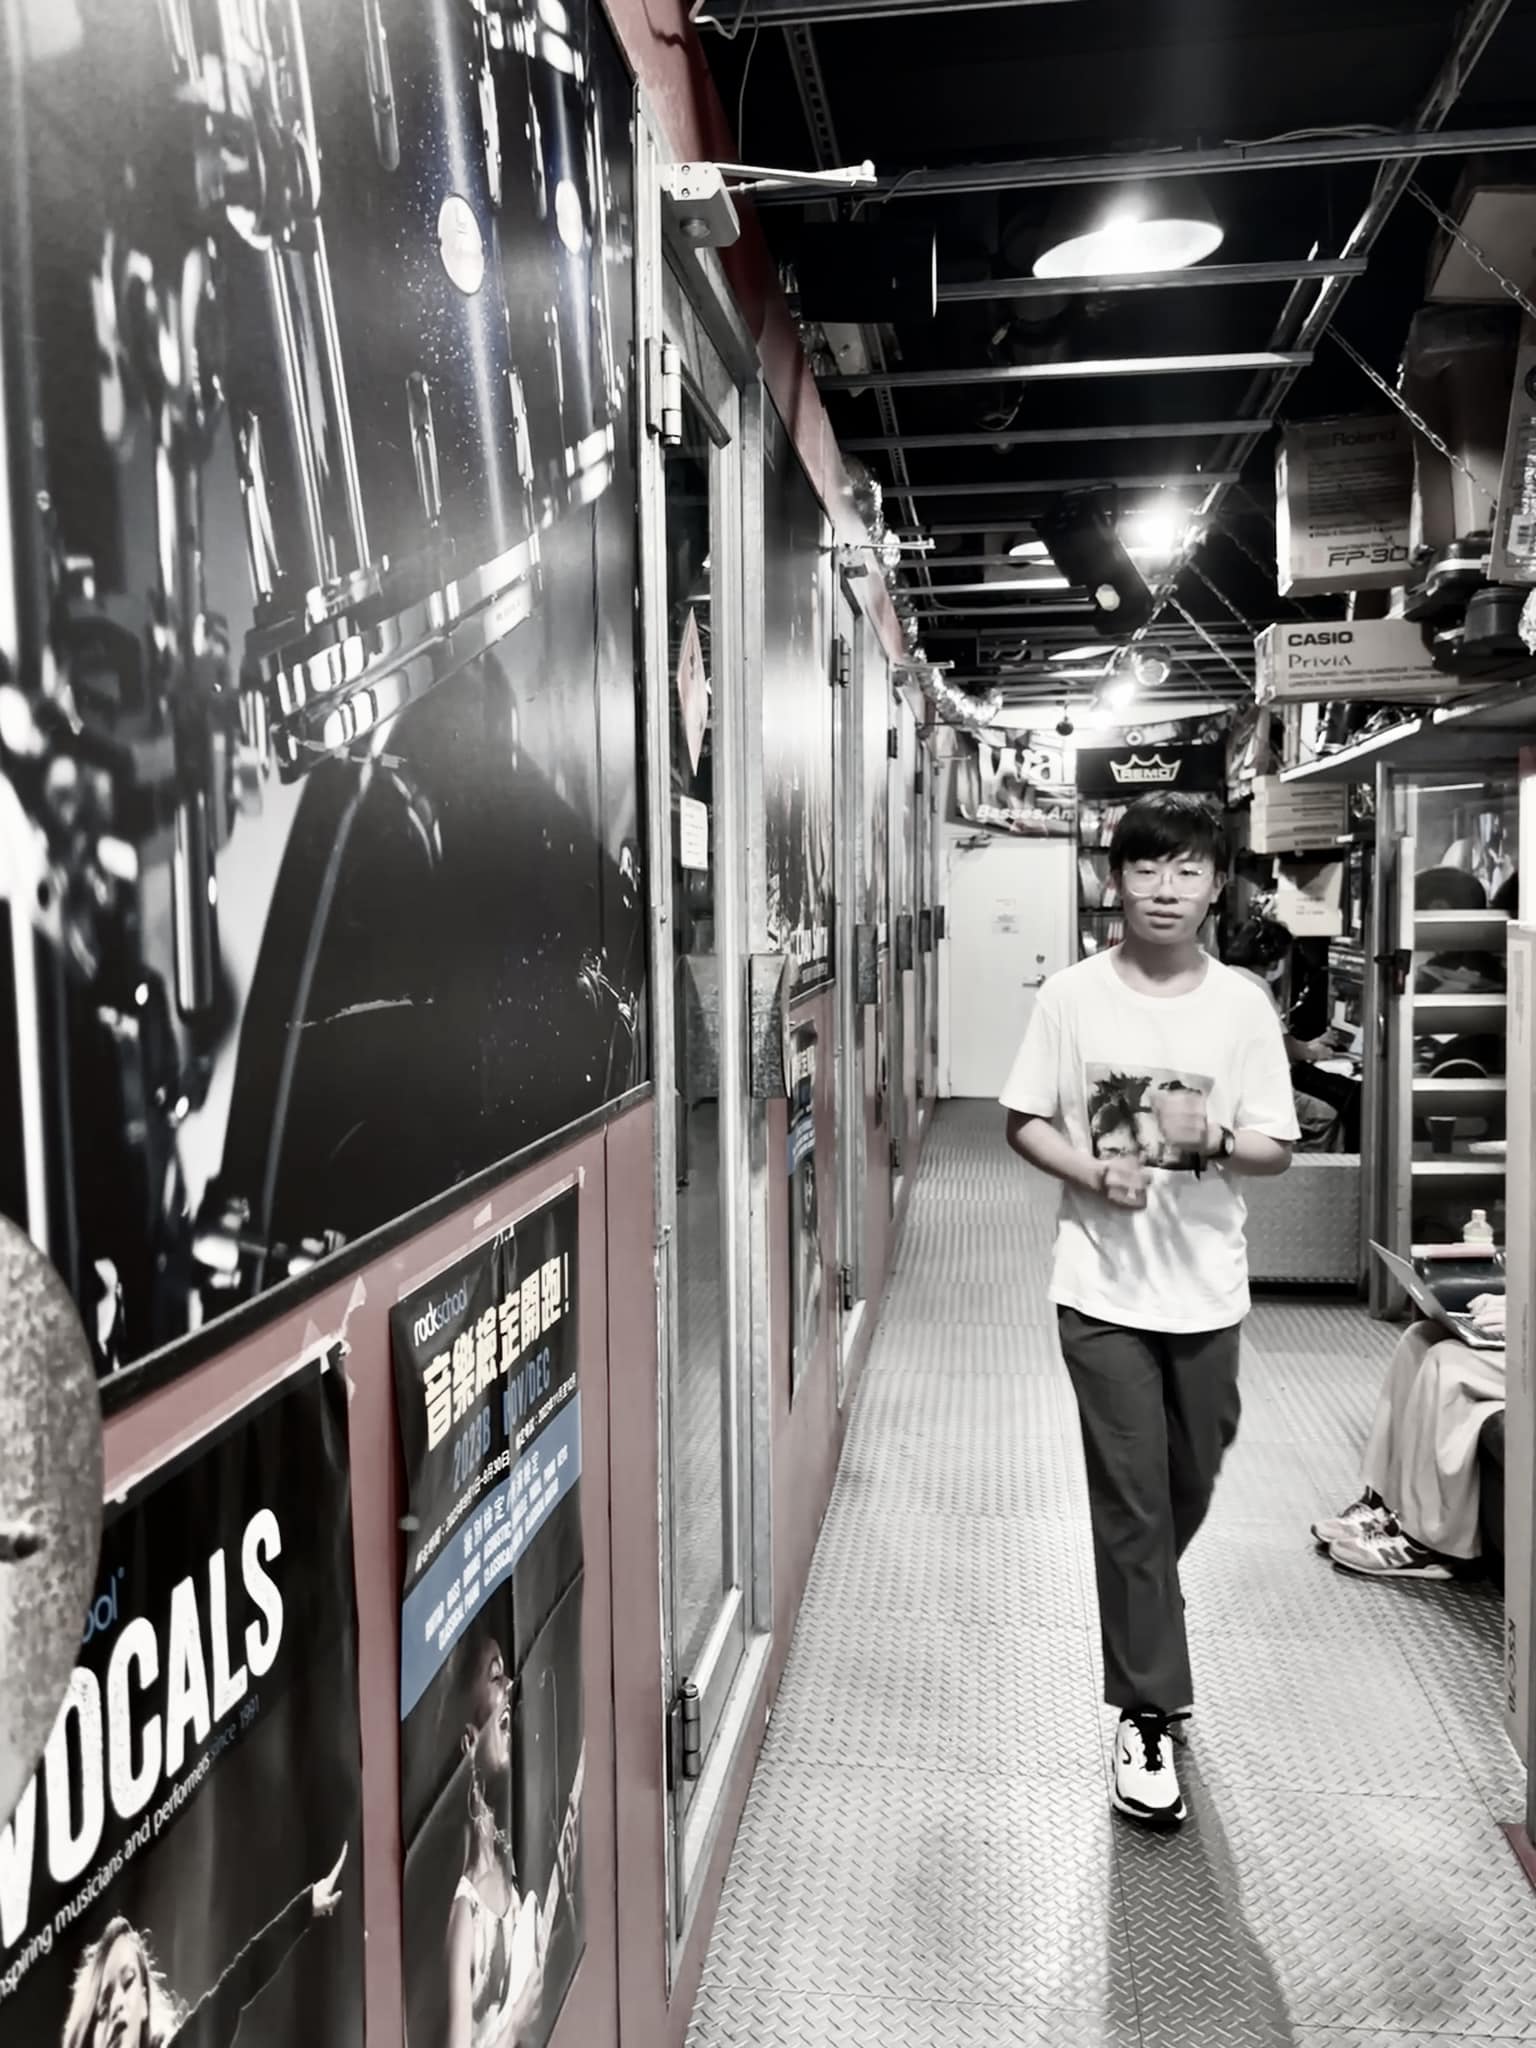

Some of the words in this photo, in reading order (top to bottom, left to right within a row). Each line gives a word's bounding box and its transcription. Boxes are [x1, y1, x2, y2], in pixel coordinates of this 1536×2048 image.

[1328, 546, 1409, 567] FP-30
[1288, 631, 1353, 647] CASIO
[414, 1276, 469, 1347] rockschool
[453, 1406, 491, 1492] 2023B
[0, 1508, 283, 1949] VOCALS
[54, 1849, 124, 1933] musicians
[123, 1822, 152, 1860] and
[153, 1750, 211, 1836] performers
